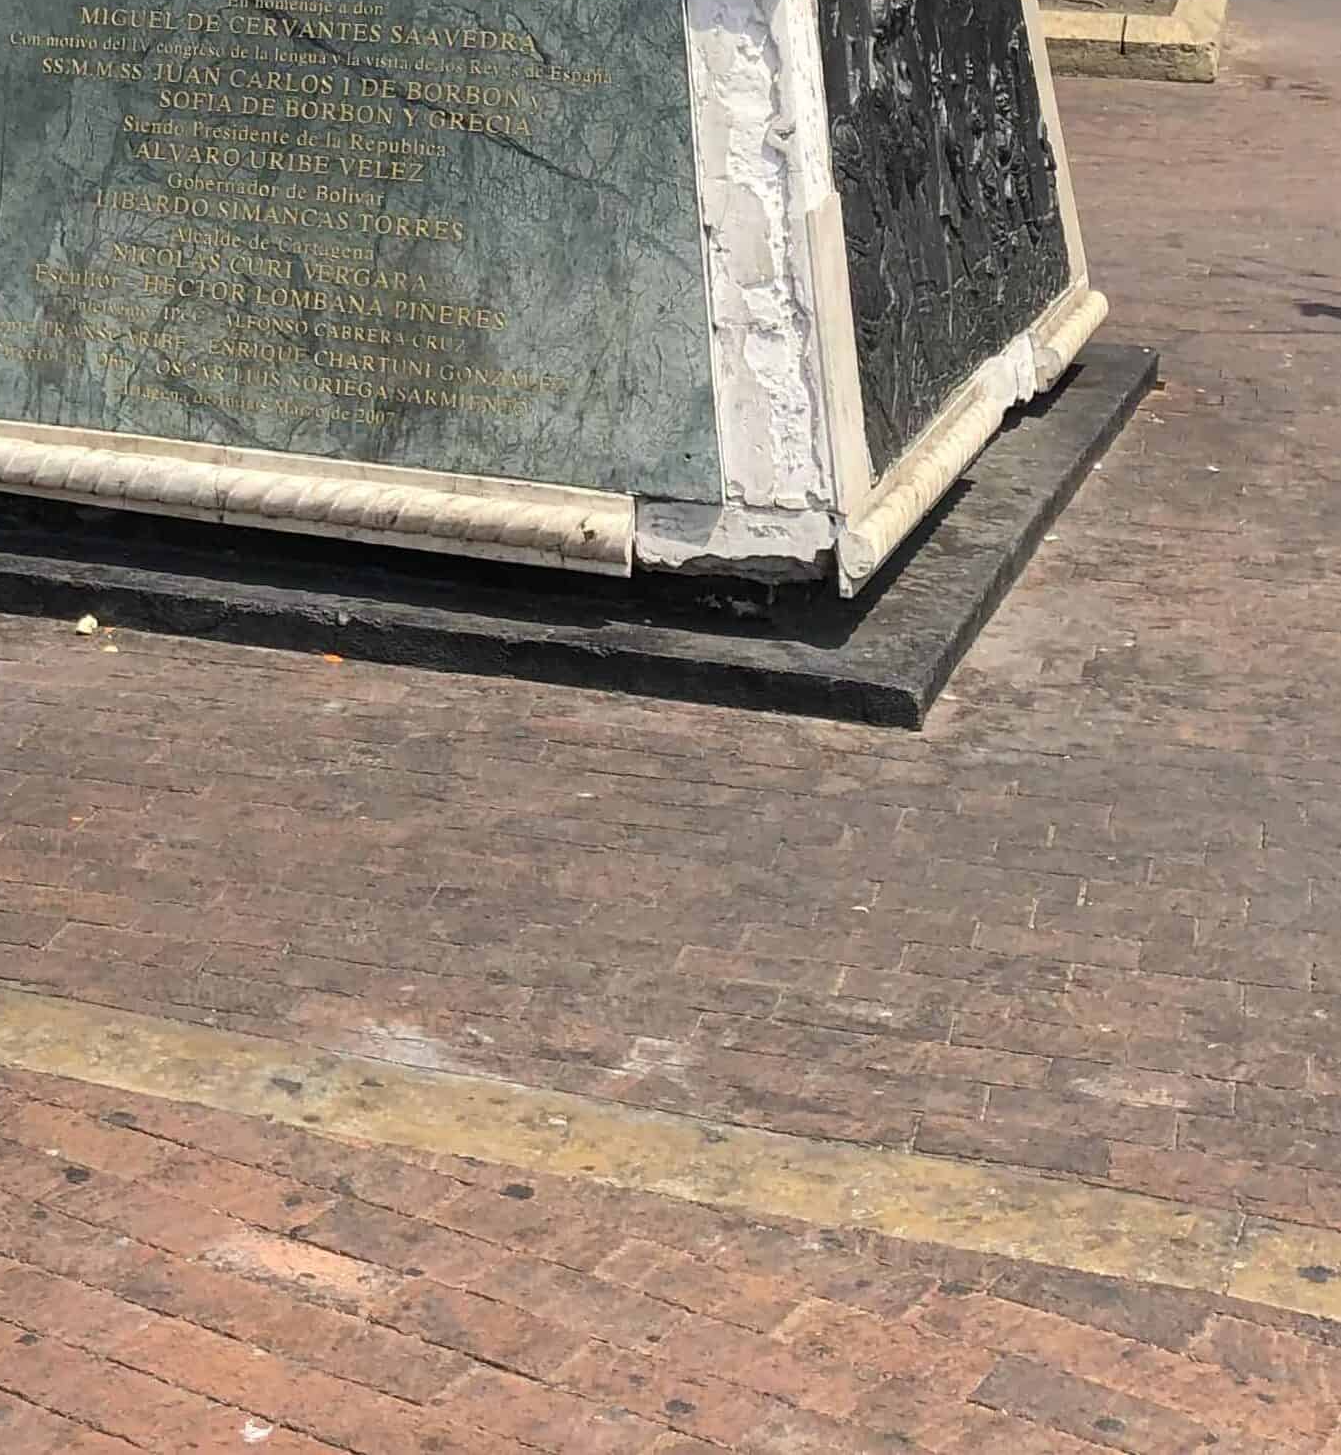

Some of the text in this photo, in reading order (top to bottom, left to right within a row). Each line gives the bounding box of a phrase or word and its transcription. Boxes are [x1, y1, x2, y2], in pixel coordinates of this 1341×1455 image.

[46, 34, 97, 49] motivo
[103, 37, 126, 51] del
[231, 46, 248, 58] de
[254, 47, 268, 59] la
[81, 7, 535, 52] MIGUEL DE CERVANTES SAAVEDRA
[154, 64, 220, 85] JUAN
[229, 69, 334, 93] CARLOS
[362, 78, 395, 98] DE
[407, 81, 520, 106] BORBON
[123, 115, 183, 135] Siendo
[193, 121, 288, 144] Presidente
[297, 130, 317, 146] de
[324, 133, 341, 147] la
[160, 90, 532, 135] SOFIA DE BORBON Y GRECIA
[134, 141, 424, 182] ALVARO URIBE VELEZ
[167, 172, 278, 197] Gobernador
[287, 184, 308, 199] de
[96, 190, 463, 241] LIBARDO SIMANCAS TORRES
[176, 225, 374, 262] Alcalde de Cartagena
[112, 245, 428, 292] NICOLAS CURI VERGARA
[143, 275, 246, 302] HECTOR
[256, 286, 383, 316] LOMBANA
[394, 297, 507, 331] PIÑERES
[291, 373, 389, 400] NORIEGA
